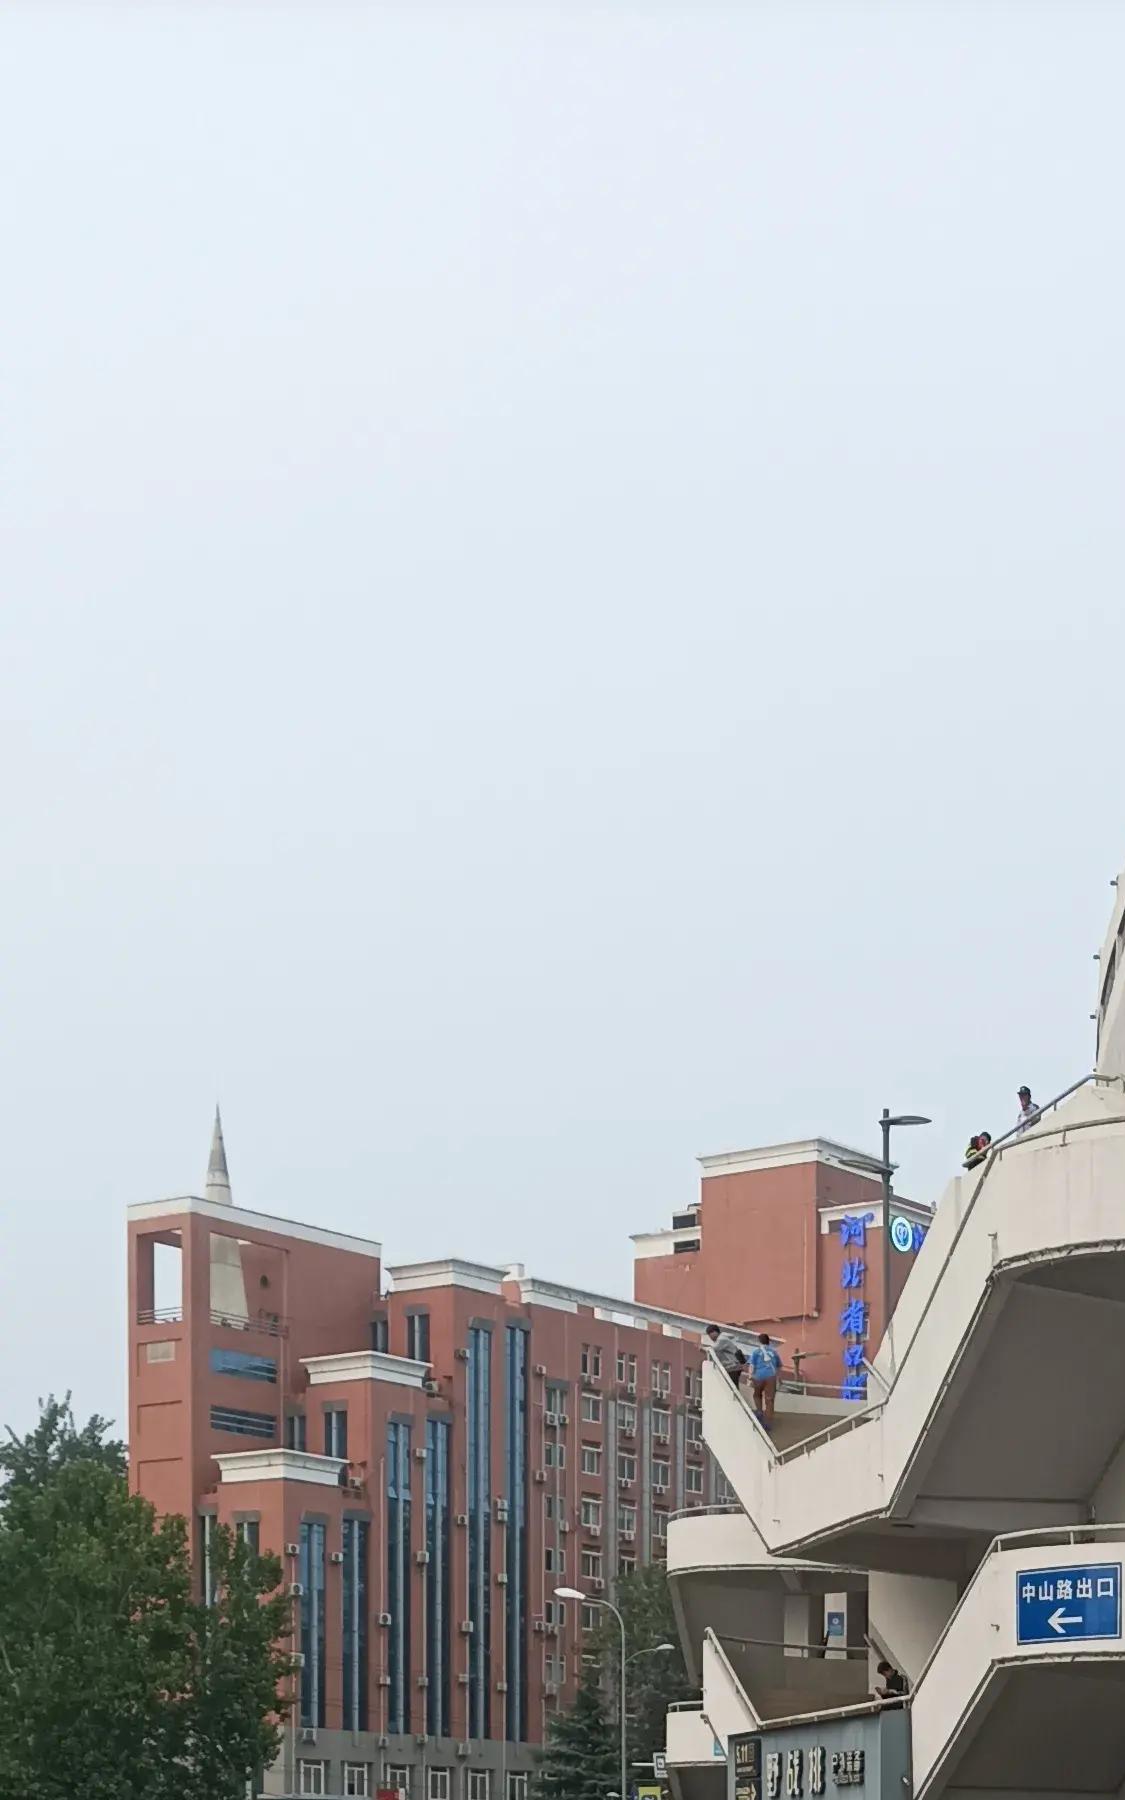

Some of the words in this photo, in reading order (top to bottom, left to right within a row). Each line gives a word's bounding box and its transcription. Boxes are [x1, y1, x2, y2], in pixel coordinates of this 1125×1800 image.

[1022, 1577, 1114, 1603] 中山路出口
